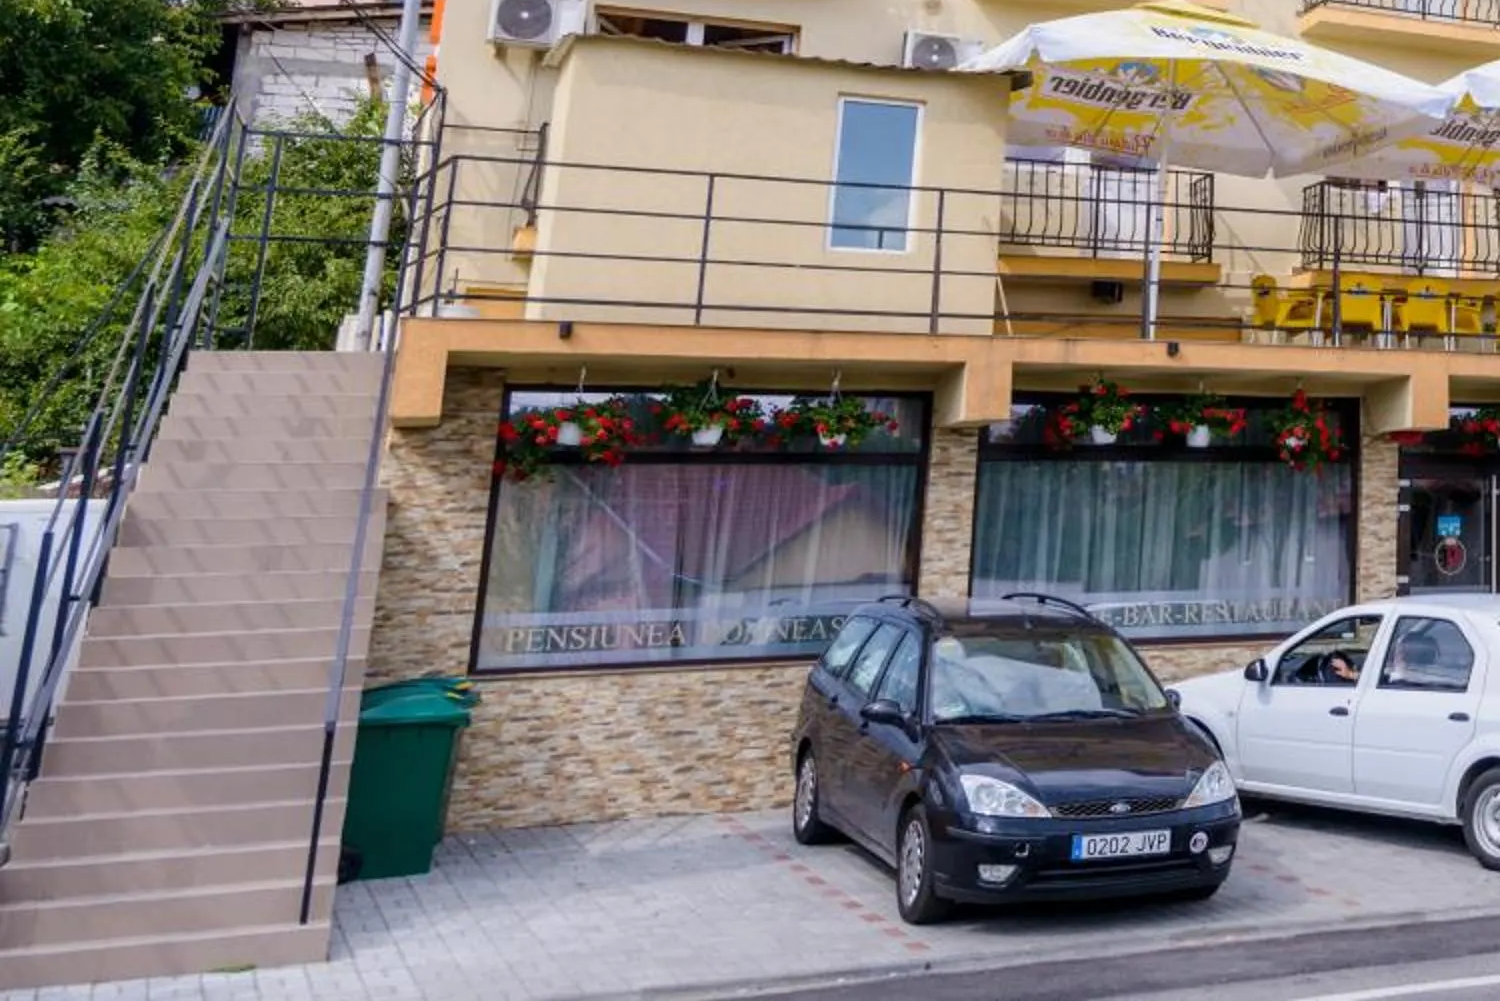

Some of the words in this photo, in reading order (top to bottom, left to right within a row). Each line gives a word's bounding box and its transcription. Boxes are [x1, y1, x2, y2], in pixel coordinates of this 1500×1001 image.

[506, 621, 687, 654] PENSIUNEA
[1087, 836, 1130, 856] 0202
[1136, 832, 1167, 852] JVP
